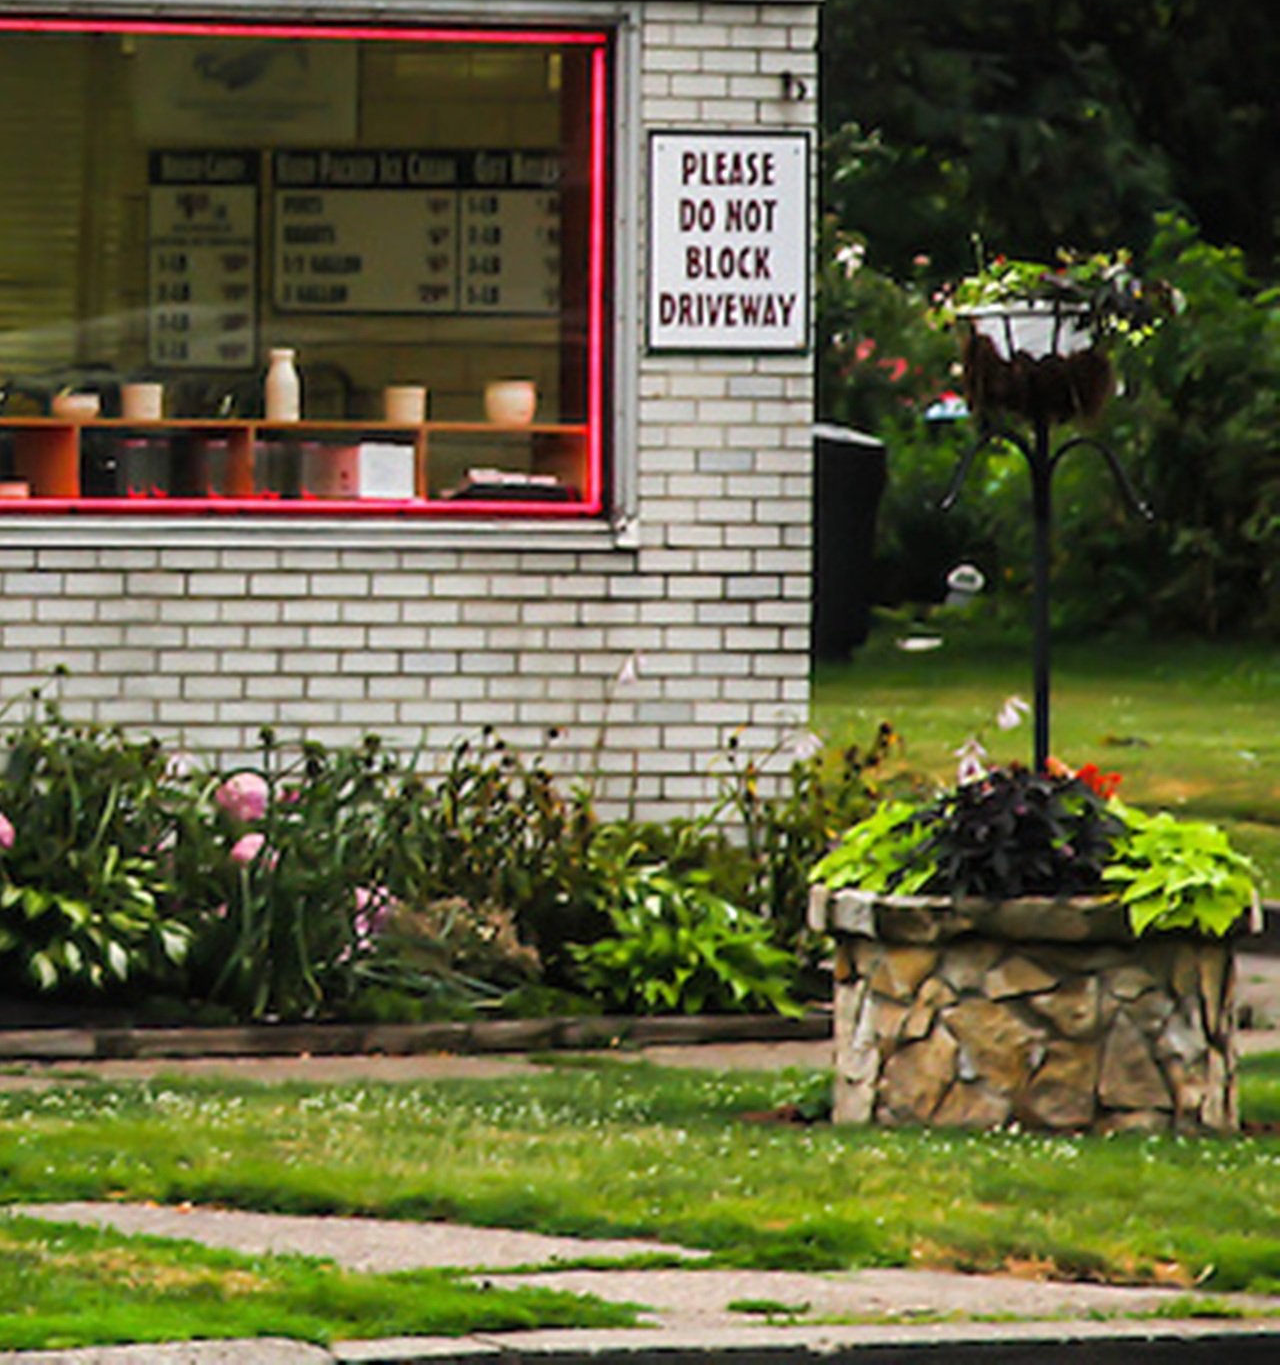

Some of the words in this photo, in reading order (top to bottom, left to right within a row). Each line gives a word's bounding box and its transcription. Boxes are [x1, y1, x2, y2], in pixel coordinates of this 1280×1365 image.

[681, 151, 775, 186] PLEASE
[679, 198, 717, 233] DO
[724, 198, 778, 233] NOT
[685, 245, 772, 280] BLOCK
[659, 291, 798, 329] DRIVEWAY
